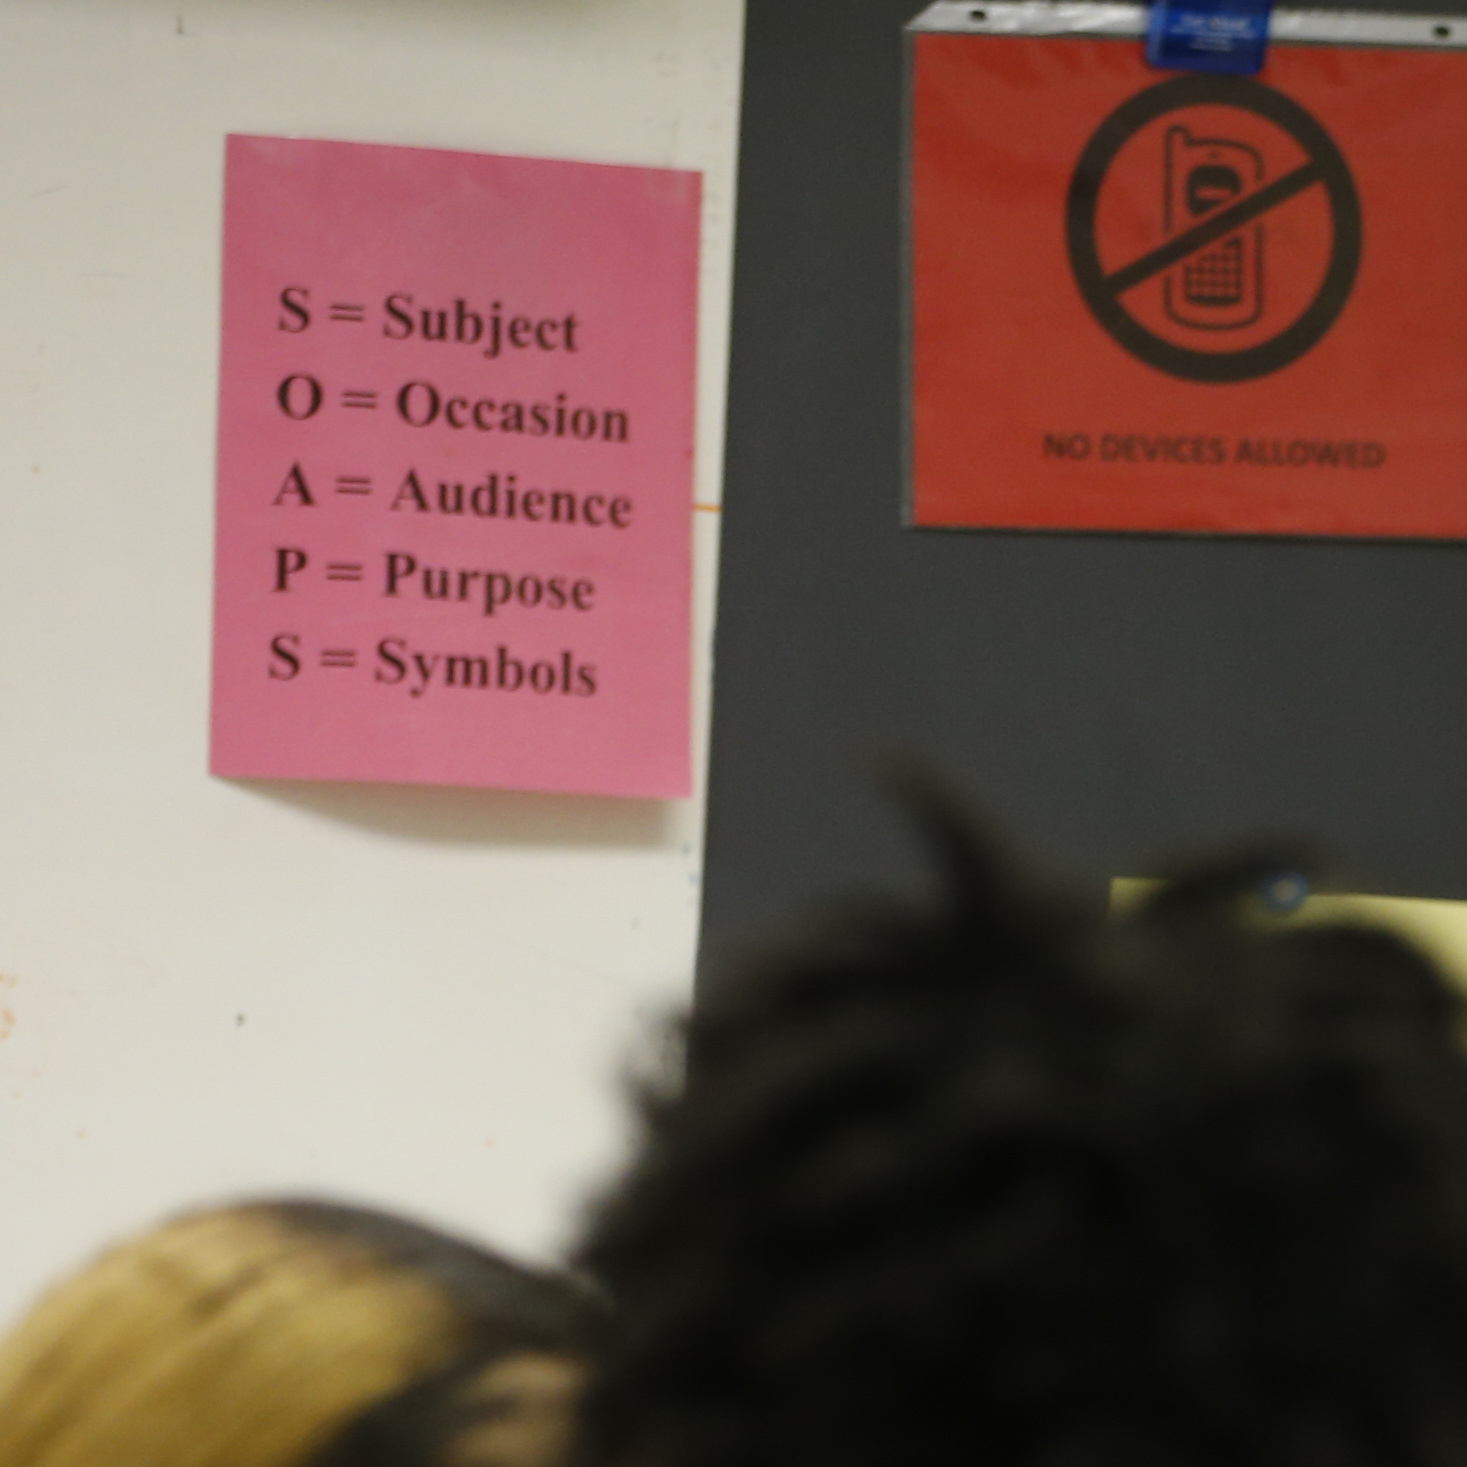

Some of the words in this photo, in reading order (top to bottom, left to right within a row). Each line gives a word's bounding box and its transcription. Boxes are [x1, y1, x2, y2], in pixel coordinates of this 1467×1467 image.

[279, 287, 312, 330] S
[328, 302, 366, 323] =
[383, 294, 578, 359] Subject
[276, 375, 325, 418] O
[340, 389, 379, 410] =
[395, 381, 629, 442] Occasion
[1042, 432, 1094, 461] NO
[1098, 432, 1230, 466] DEVICES
[1233, 437, 1389, 470] ALLOWED
[272, 462, 318, 507] A
[335, 475, 373, 496] =
[389, 467, 635, 530] Audience
[275, 547, 309, 592] P
[325, 561, 365, 582] =
[385, 551, 595, 617] Purpose
[270, 636, 302, 677] S
[319, 648, 358, 669] =
[375, 639, 598, 697] Symbols
